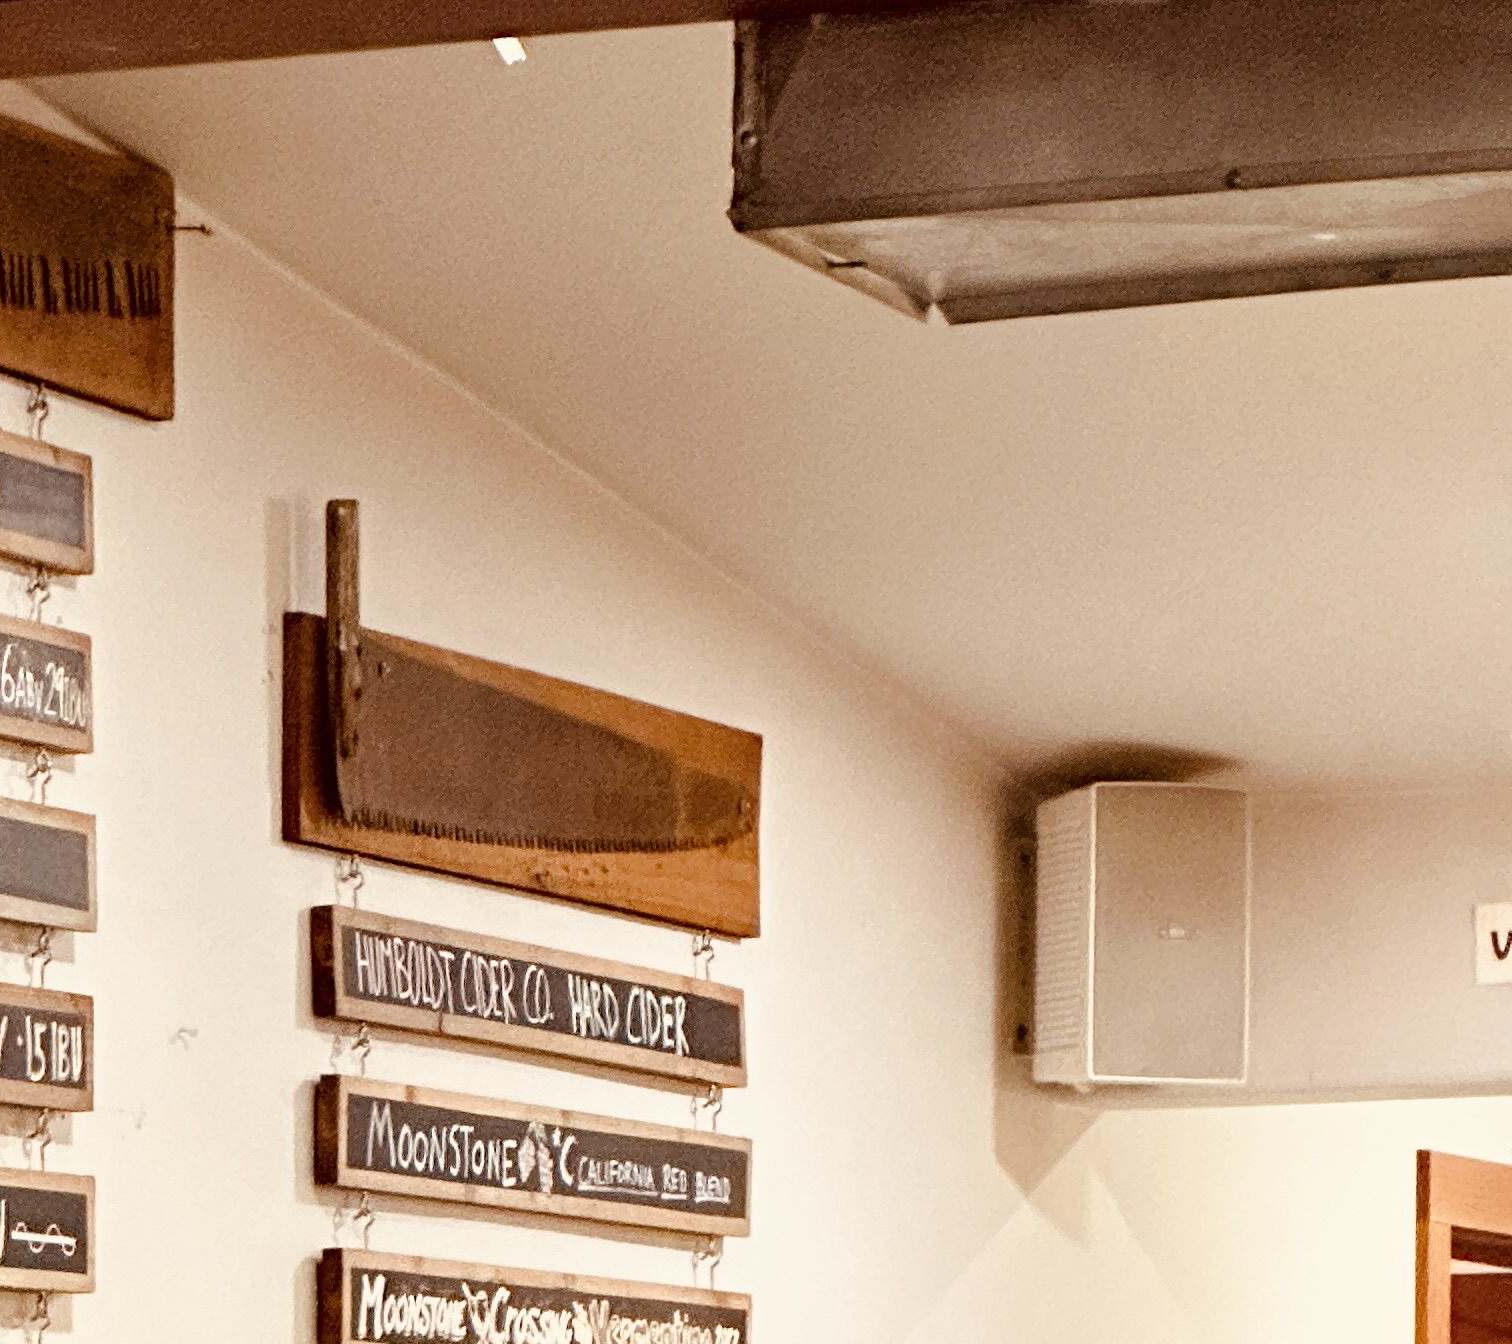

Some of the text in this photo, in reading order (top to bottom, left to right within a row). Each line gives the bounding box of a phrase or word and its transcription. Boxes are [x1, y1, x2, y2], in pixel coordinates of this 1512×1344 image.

[355, 931, 455, 1014] HUMBOLDT
[460, 951, 517, 1024] CIDER
[567, 973, 619, 1041] HARD
[626, 986, 690, 1057] CIDER
